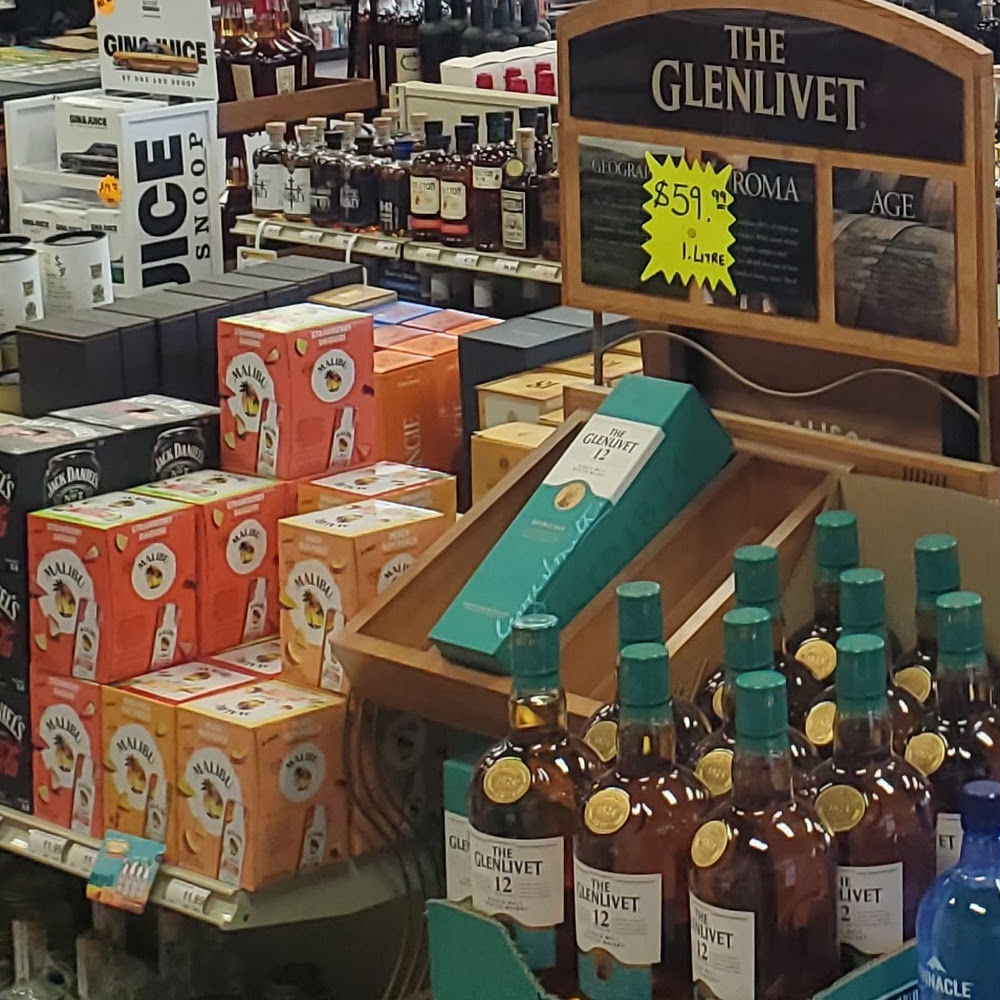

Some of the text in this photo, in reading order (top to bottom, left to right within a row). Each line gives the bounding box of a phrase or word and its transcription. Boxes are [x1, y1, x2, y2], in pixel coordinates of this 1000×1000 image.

[724, 24, 785, 64] THE
[651, 59, 865, 131] GLENLIVET
[188, 131, 211, 260] SNOOP
[730, 171, 800, 202] ROMA
[870, 189, 914, 219] AGE
[317, 357, 347, 373] MALIBU
[231, 365, 266, 388] MALIBU
[582, 432, 639, 453] GLENLIVET
[609, 428, 626, 438] THE
[155, 448, 173, 473] JACK
[593, 448, 611, 461] 12
[47, 465, 99, 498] JACK DANIEL'S
[232, 528, 260, 545] MALIBU
[137, 551, 168, 569] MALIBU
[44, 562, 85, 589] MALIBU
[294, 572, 334, 599] MALIBU
[46, 717, 82, 745] MALIBU
[116, 736, 155, 765] MALIBU
[285, 750, 317, 770] MALIBU
[192, 760, 234, 790] MALIBU
[474, 850, 543, 876] GLENLIVET
[492, 846, 513, 859] THE
[495, 876, 513, 893] 12
[590, 878, 611, 893] THE
[577, 881, 641, 913] GLENLIVET
[839, 887, 884, 905] LIVET
[593, 909, 609, 927] 12
[695, 909, 708, 923] THE
[840, 904, 851, 922] 2
[697, 943, 709, 962] 12
